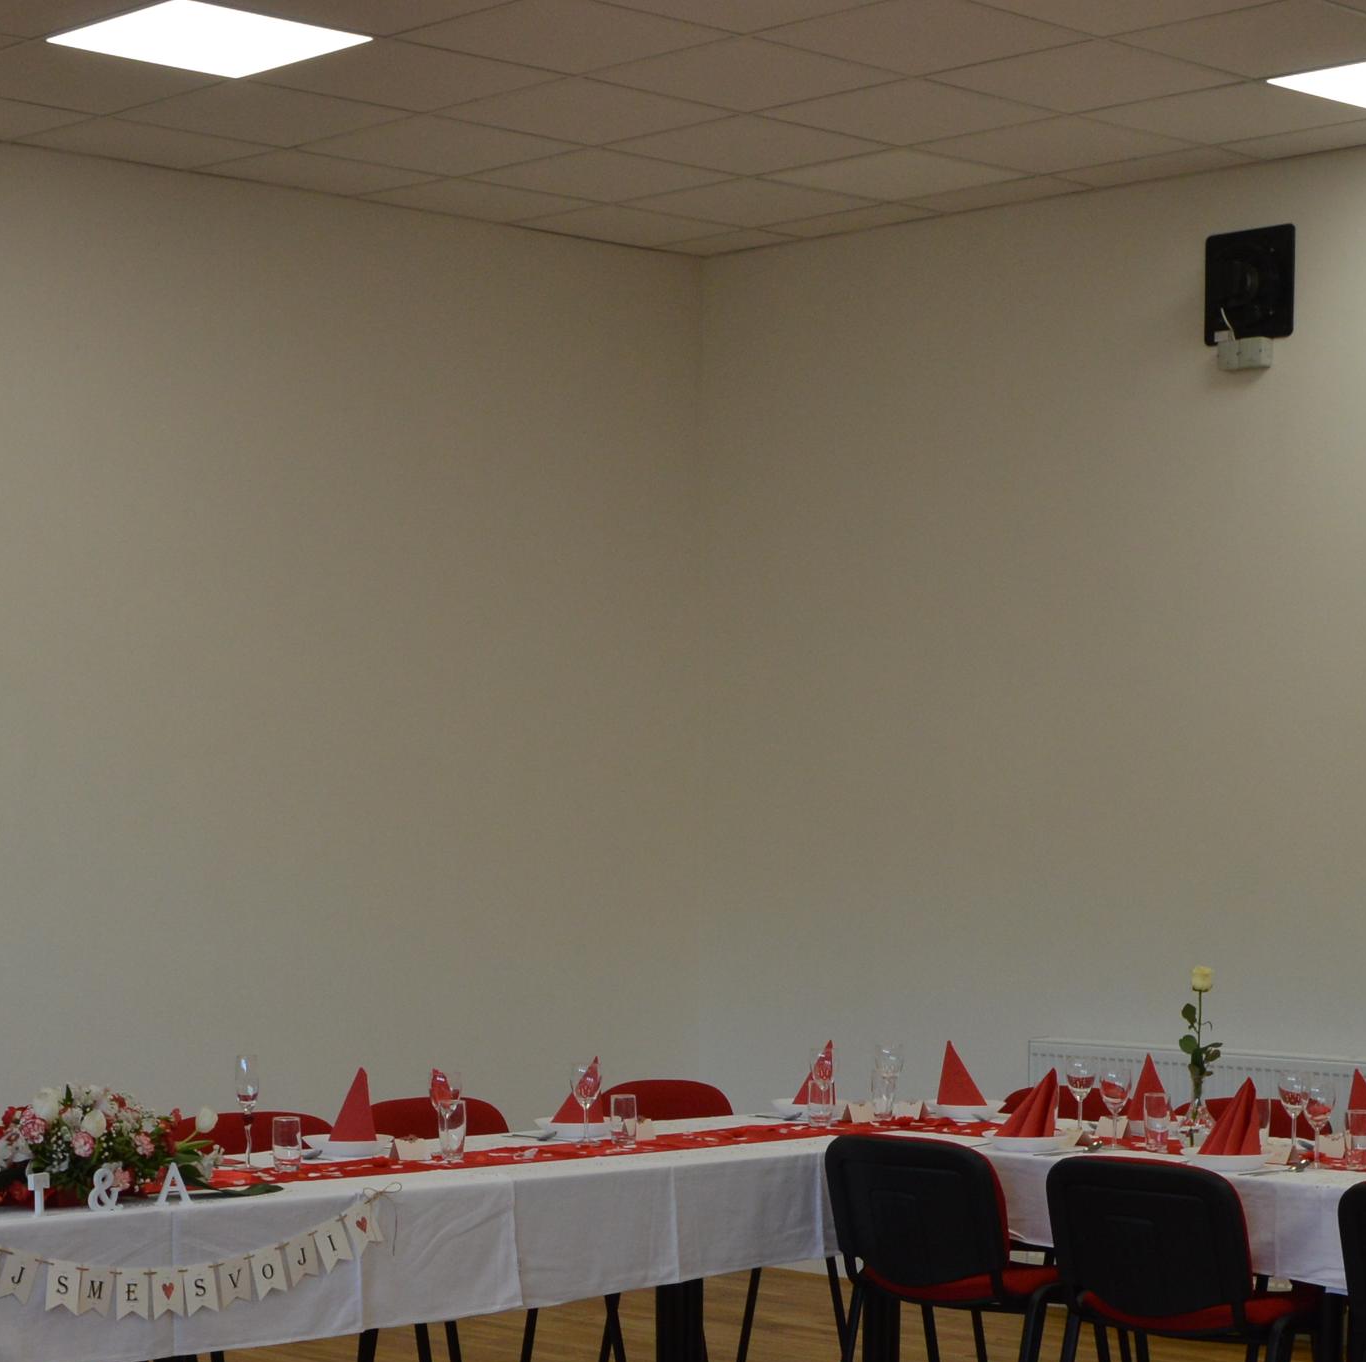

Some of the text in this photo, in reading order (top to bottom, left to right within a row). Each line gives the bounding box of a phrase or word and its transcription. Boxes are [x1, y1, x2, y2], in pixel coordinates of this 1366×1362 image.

[88, 1167, 123, 1212] &
[154, 1161, 194, 1207] A
[11, 1233, 338, 1303] JSME SVOJI
